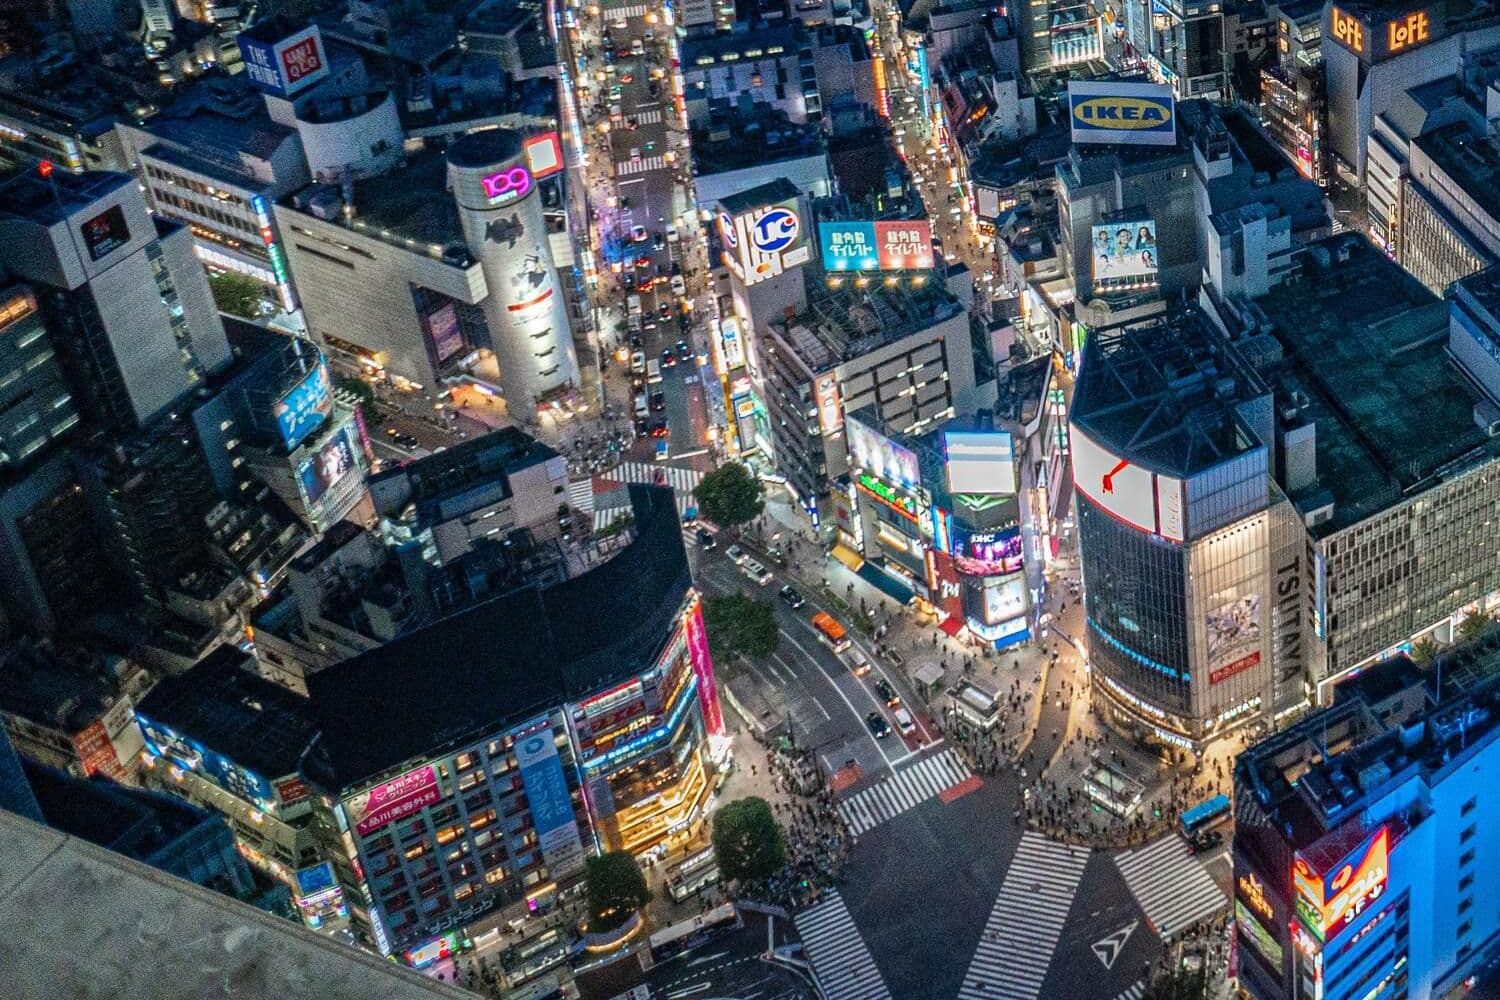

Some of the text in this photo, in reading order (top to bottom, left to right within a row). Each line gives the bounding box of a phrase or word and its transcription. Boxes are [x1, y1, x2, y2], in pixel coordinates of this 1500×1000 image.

[247, 45, 271, 67] THE
[286, 42, 312, 64] UNI
[290, 55, 317, 77] QLO
[1082, 105, 1164, 121] IKEA
[482, 167, 530, 198] 109
[971, 533, 995, 543] DHC
[1277, 555, 1301, 684] TSUTAYA
[1217, 696, 1262, 722] TSUTAYA
[1154, 728, 1193, 750] TSUTAYA
[1331, 867, 1384, 922] アコム
